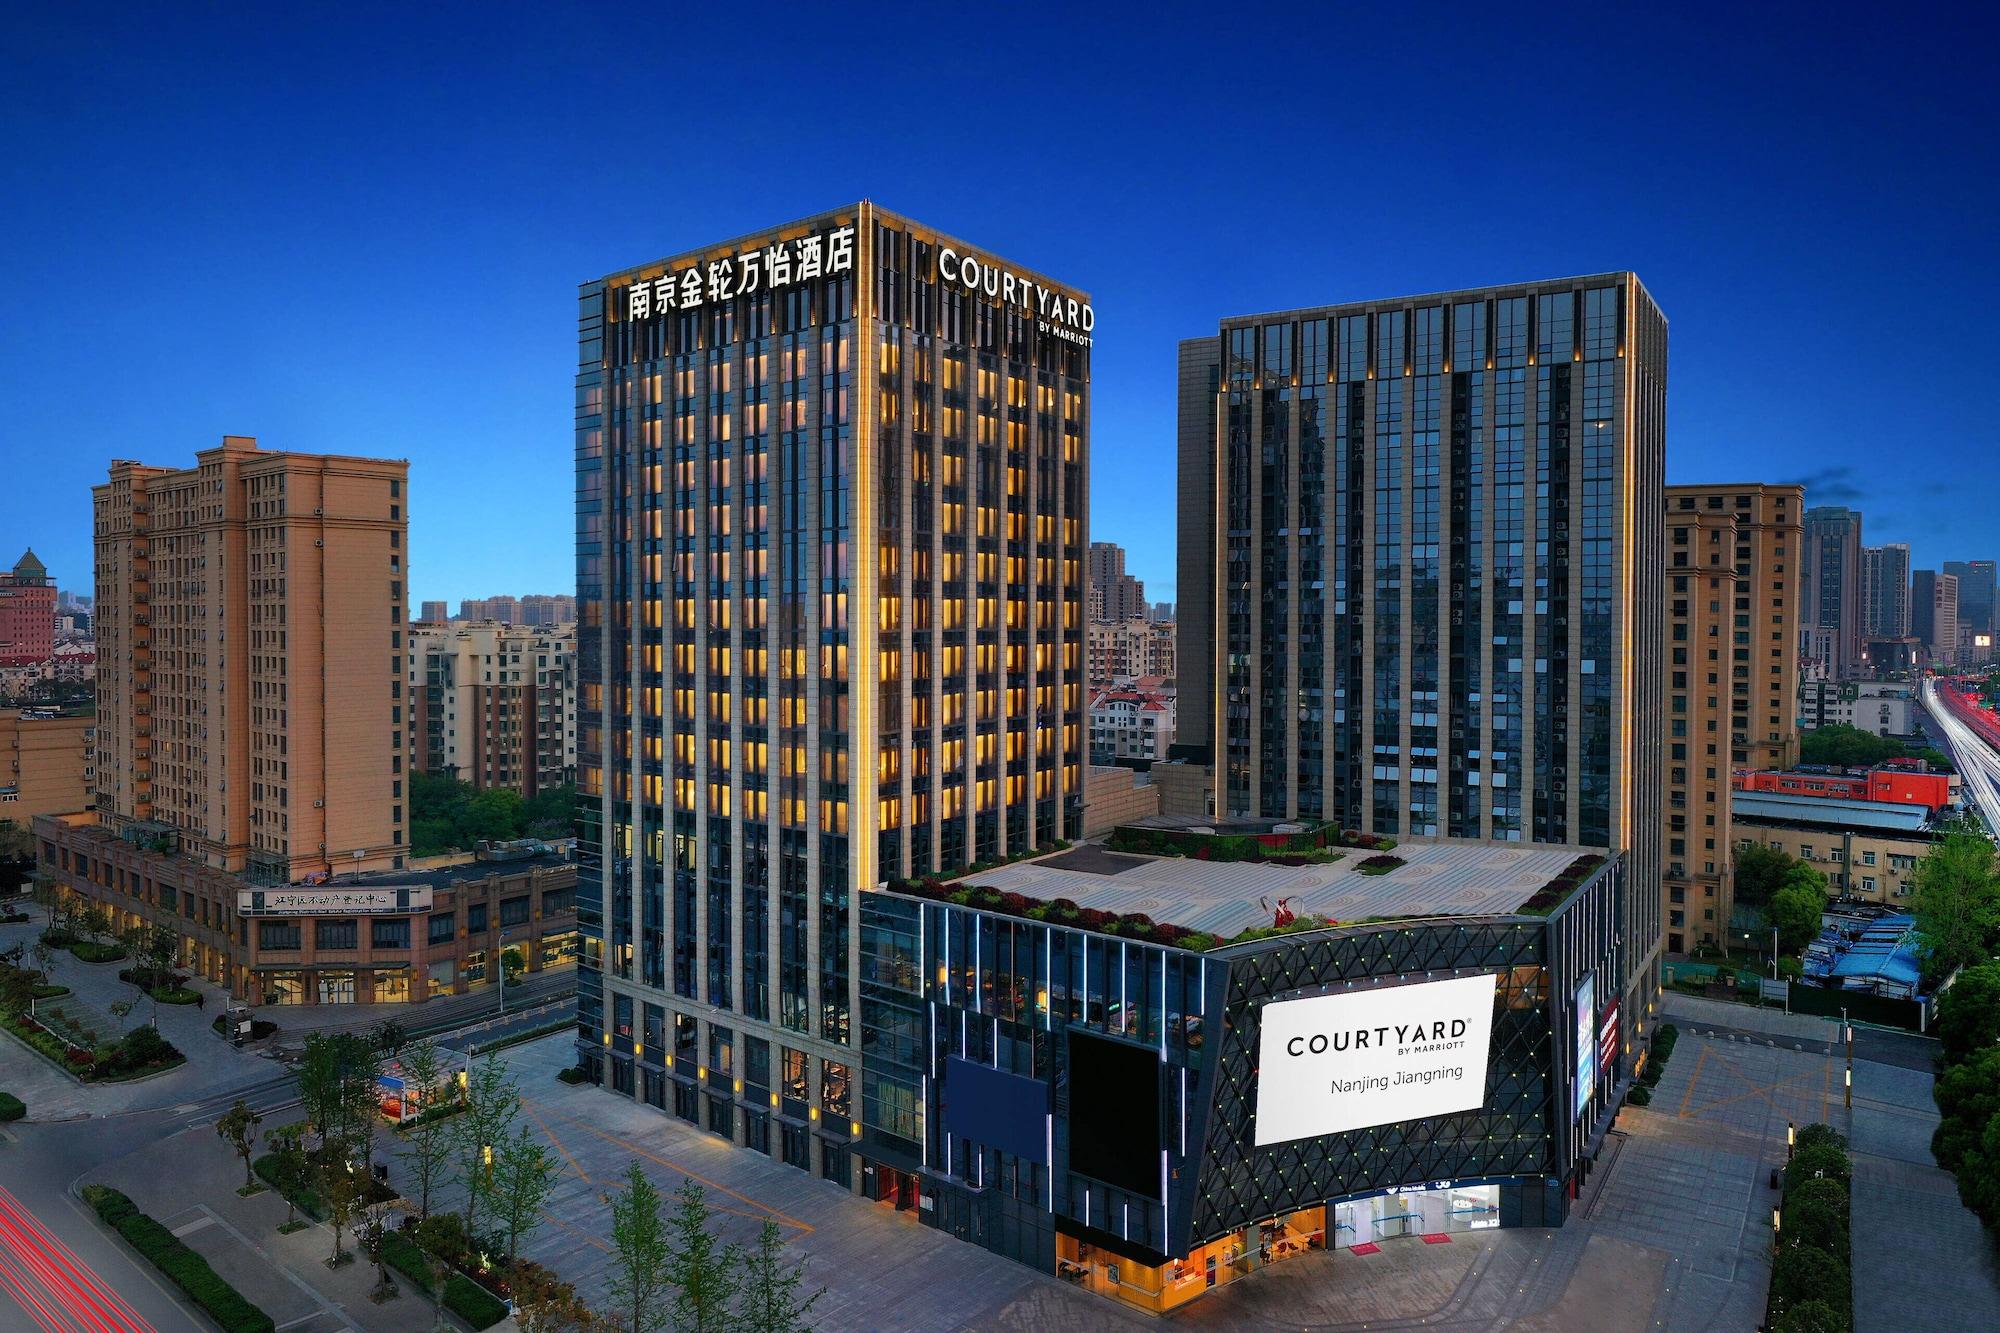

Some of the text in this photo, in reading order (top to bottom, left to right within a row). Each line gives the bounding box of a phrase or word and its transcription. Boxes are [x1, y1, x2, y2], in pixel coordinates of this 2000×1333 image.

[628, 227, 855, 323] 南京金轮万怡酒店
[939, 248, 1095, 332] COURTYARD
[1039, 320, 1094, 348] BY MARRIOTT
[274, 893, 387, 906] 江宁区不动产登记中心
[1397, 1041, 1465, 1056] BY MARRIOTT
[1331, 1066, 1463, 1094] Nanjing Jiangning
